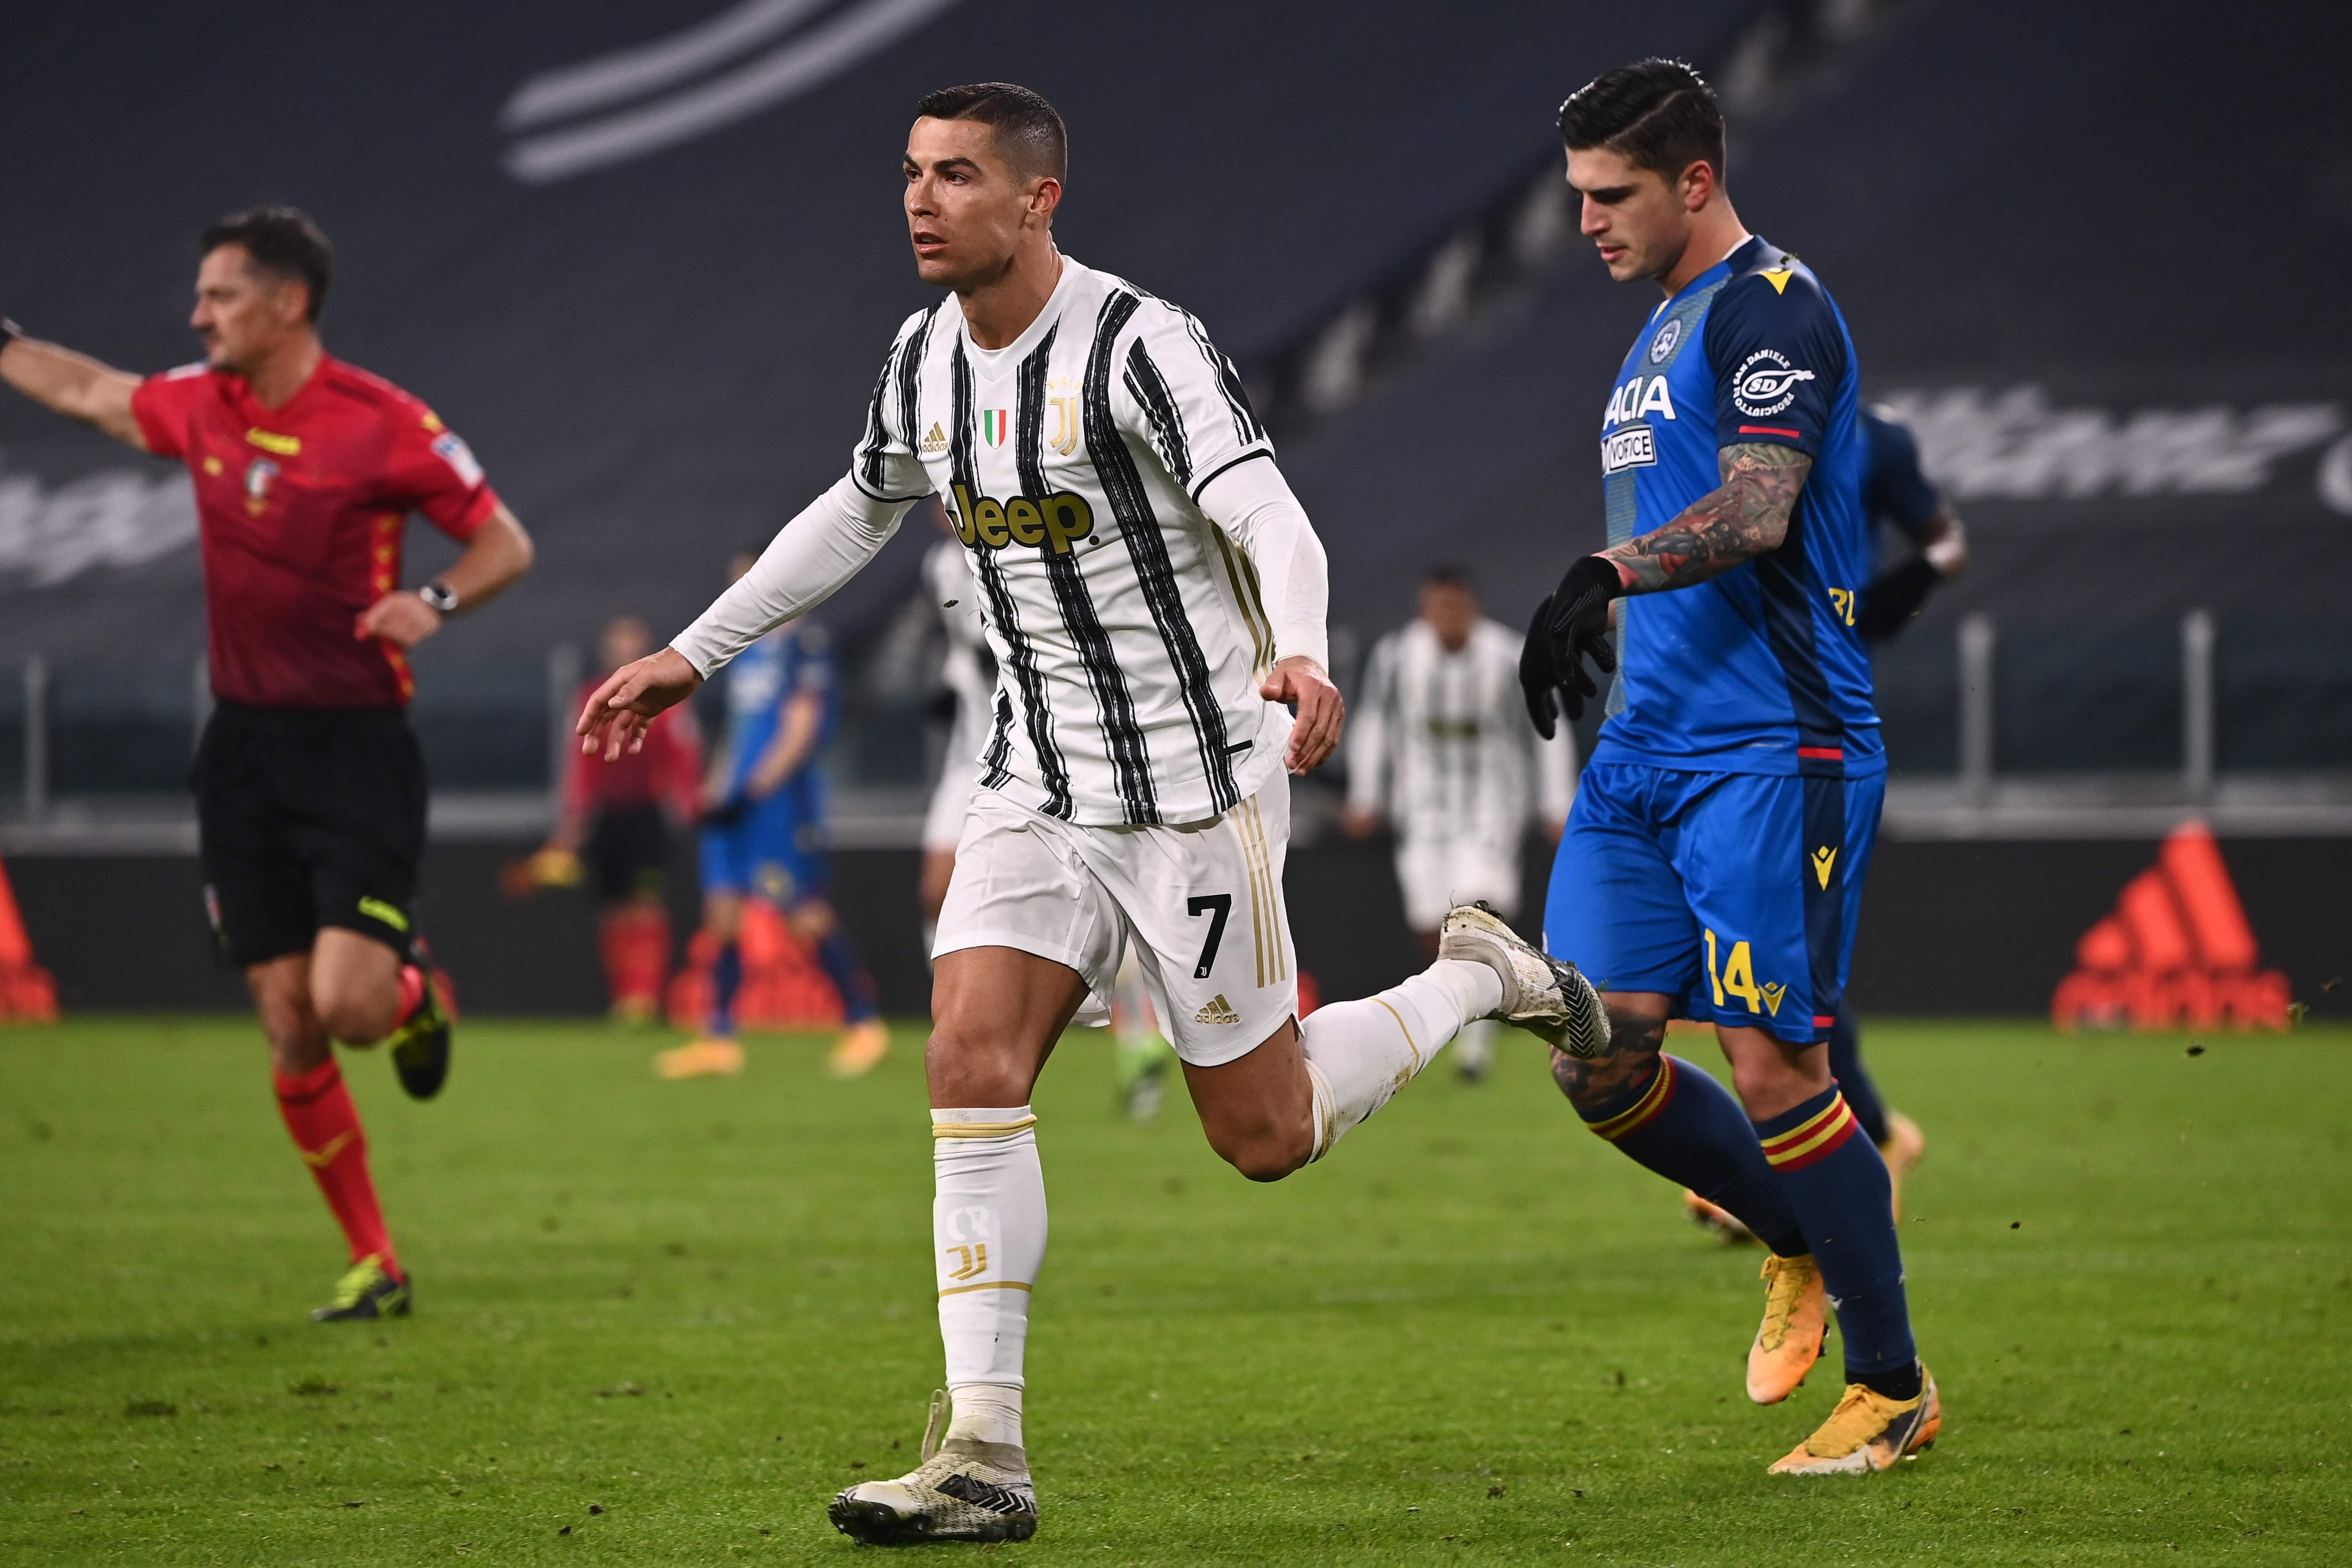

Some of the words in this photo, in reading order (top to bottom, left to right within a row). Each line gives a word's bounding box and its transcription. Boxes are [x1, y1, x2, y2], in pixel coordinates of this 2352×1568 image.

[1746, 349, 1791, 370] DANIELE
[1733, 363, 1748, 385] SAN
[1748, 378, 1777, 392] SD
[1602, 375, 1676, 431] ACIA
[1735, 391, 1795, 417] PROSCIUTTO
[922, 441, 948, 453] adidas
[948, 482, 1093, 555] Jeep
[1187, 893, 1232, 979] 7
[1704, 928, 1761, 1015] 14
[1194, 1013, 1240, 1024] adidas
